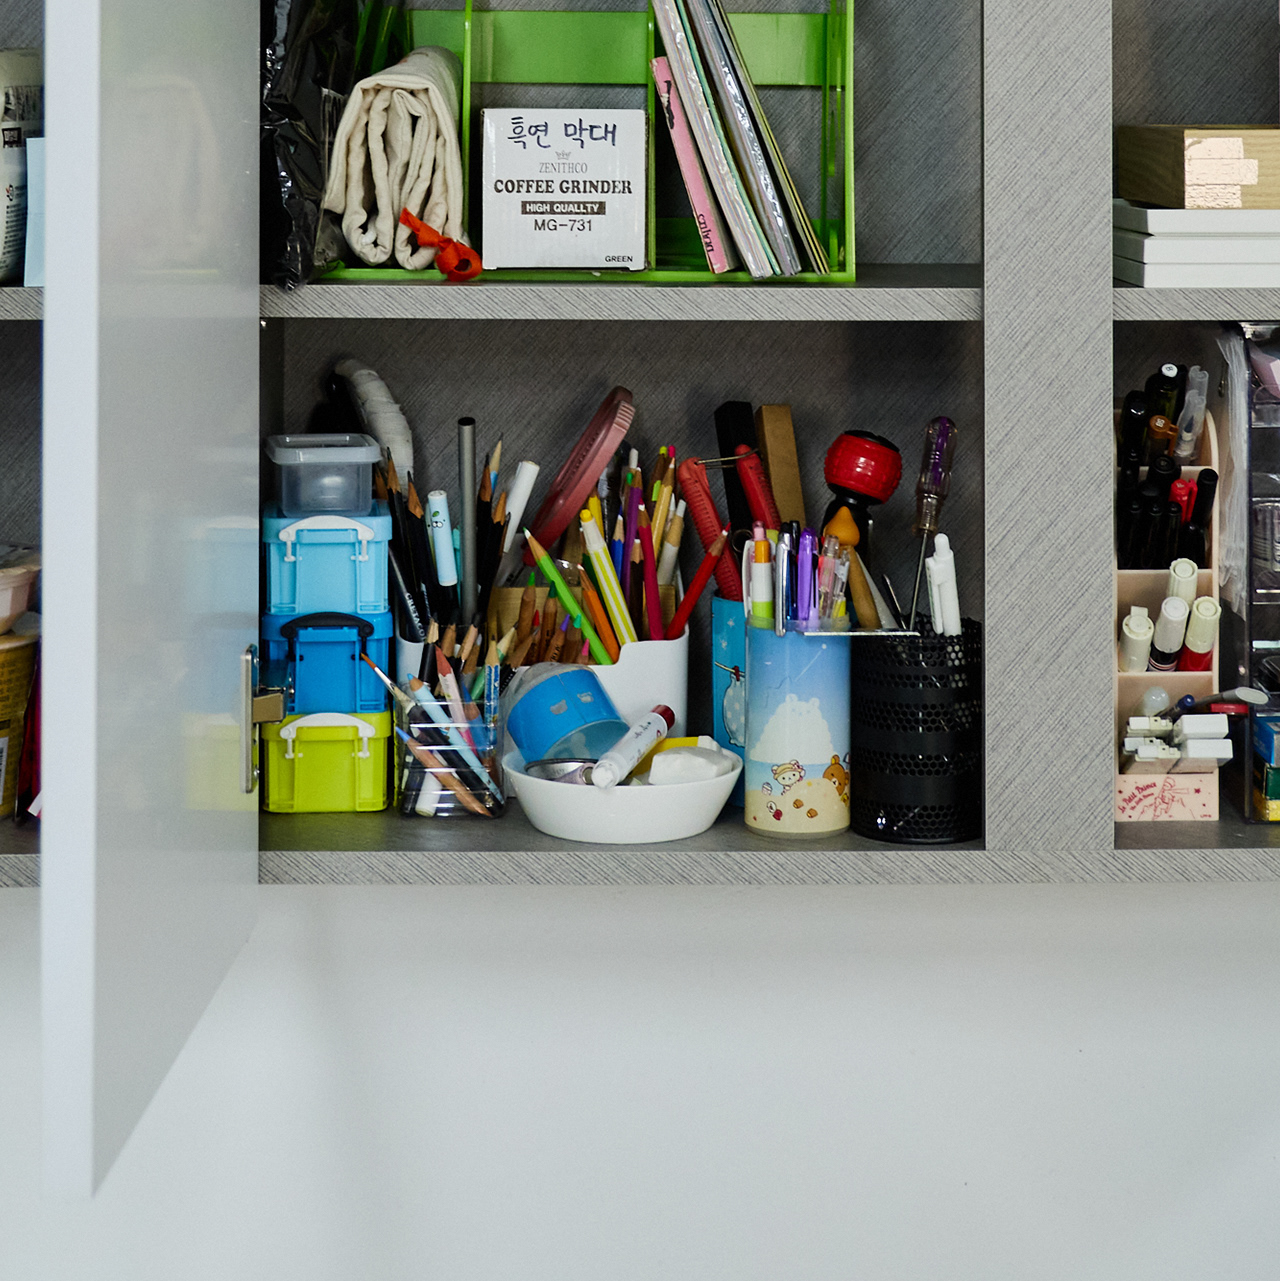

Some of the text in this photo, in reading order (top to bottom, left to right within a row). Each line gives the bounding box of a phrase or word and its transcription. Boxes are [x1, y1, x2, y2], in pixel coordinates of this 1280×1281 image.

[507, 116, 617, 150] 흑연 막대
[538, 162, 588, 174] ZENITHCO
[494, 179, 632, 195] COFFEE GRINDER
[526, 203, 550, 213] HIGH
[534, 218, 593, 232] MG-731
[604, 255, 633, 263] GREEN
